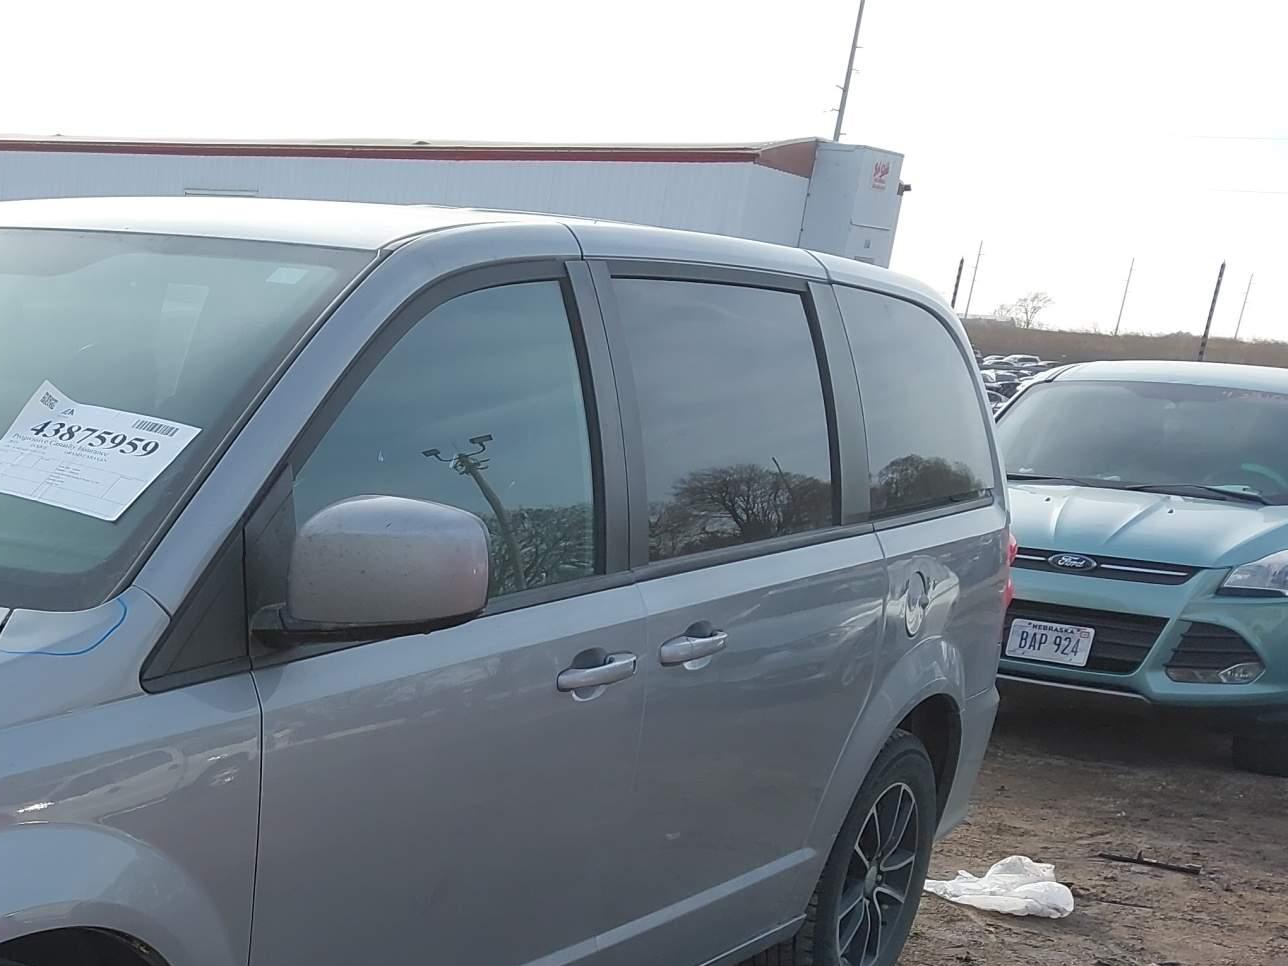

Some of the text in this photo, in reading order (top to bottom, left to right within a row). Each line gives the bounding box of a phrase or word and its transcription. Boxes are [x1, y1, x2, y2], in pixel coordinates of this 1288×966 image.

[30, 420, 160, 457] 43875959
[1057, 555, 1087, 569] Ford
[1031, 623, 1074, 635] NEBRASKA
[1018, 630, 1081, 657] BAP 924
